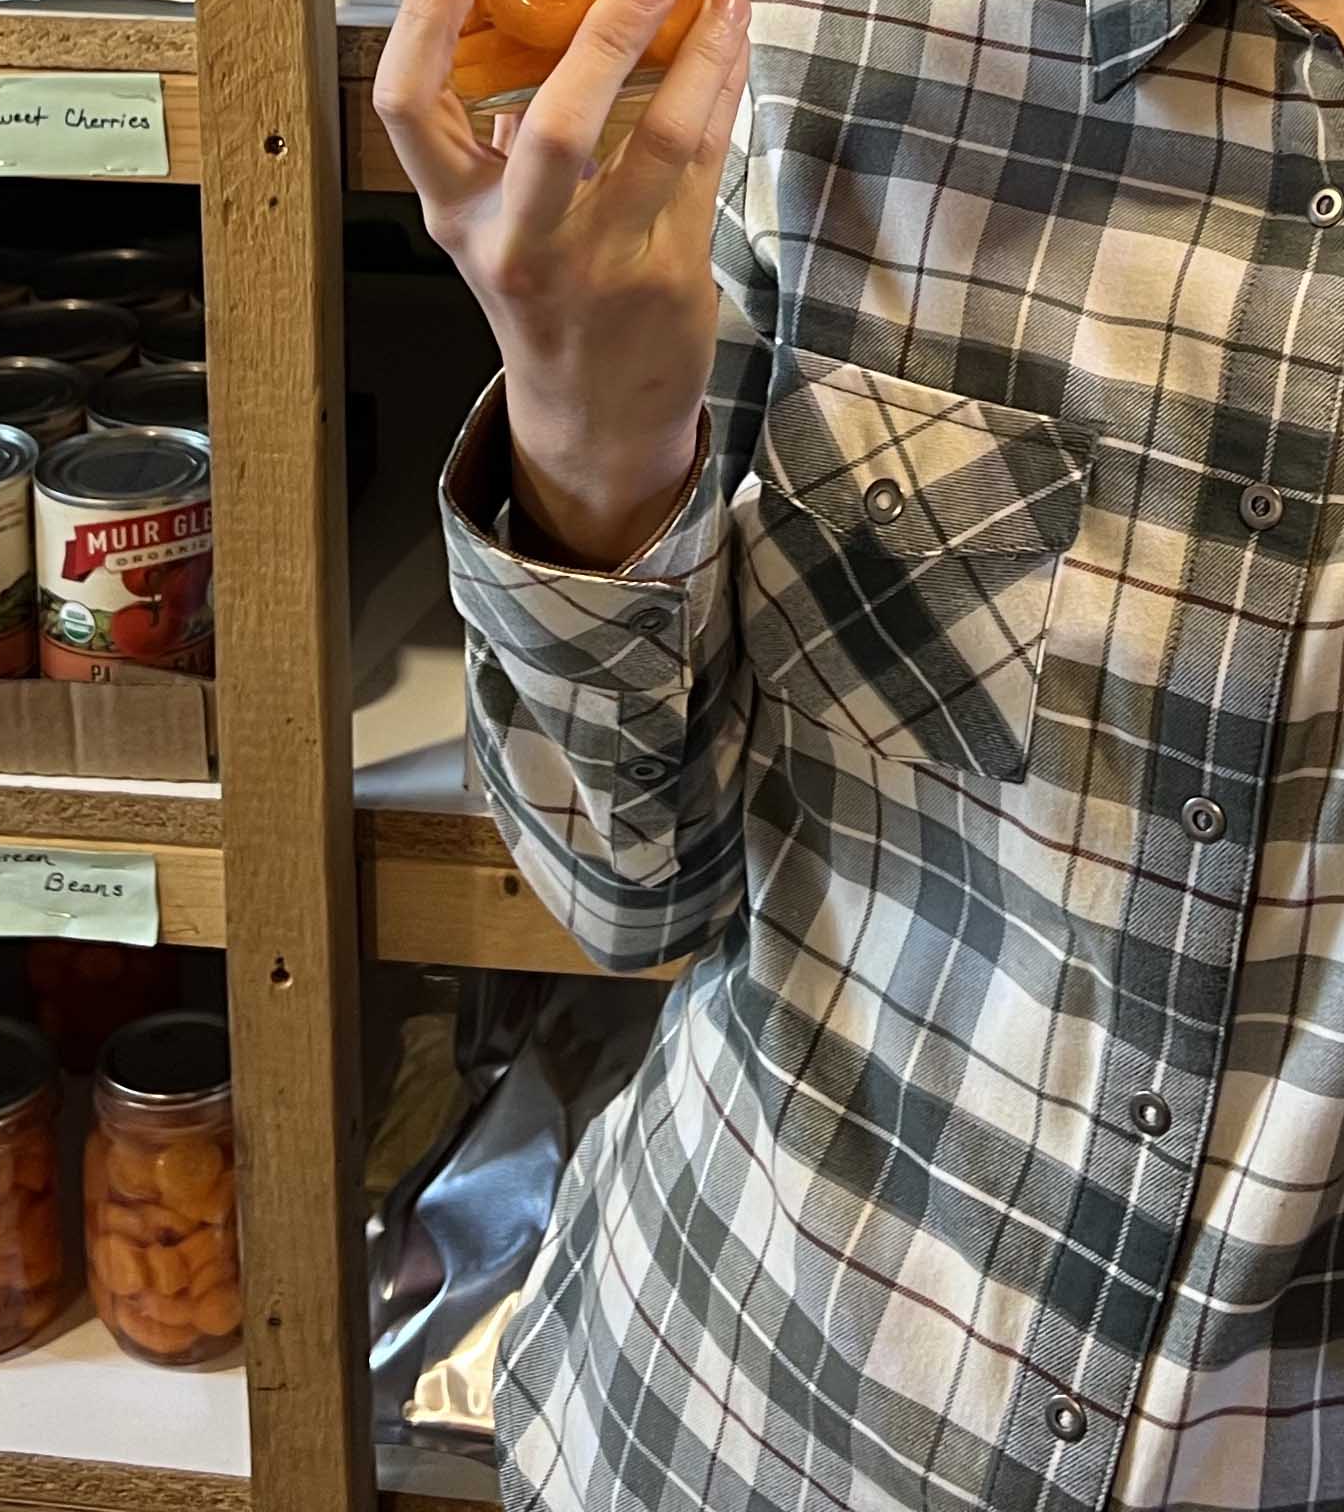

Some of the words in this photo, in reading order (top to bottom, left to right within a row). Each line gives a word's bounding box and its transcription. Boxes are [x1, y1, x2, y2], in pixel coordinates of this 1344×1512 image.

[64, 107, 151, 130] Cherries
[87, 519, 160, 555] MUIR
[43, 871, 124, 897] Beans
